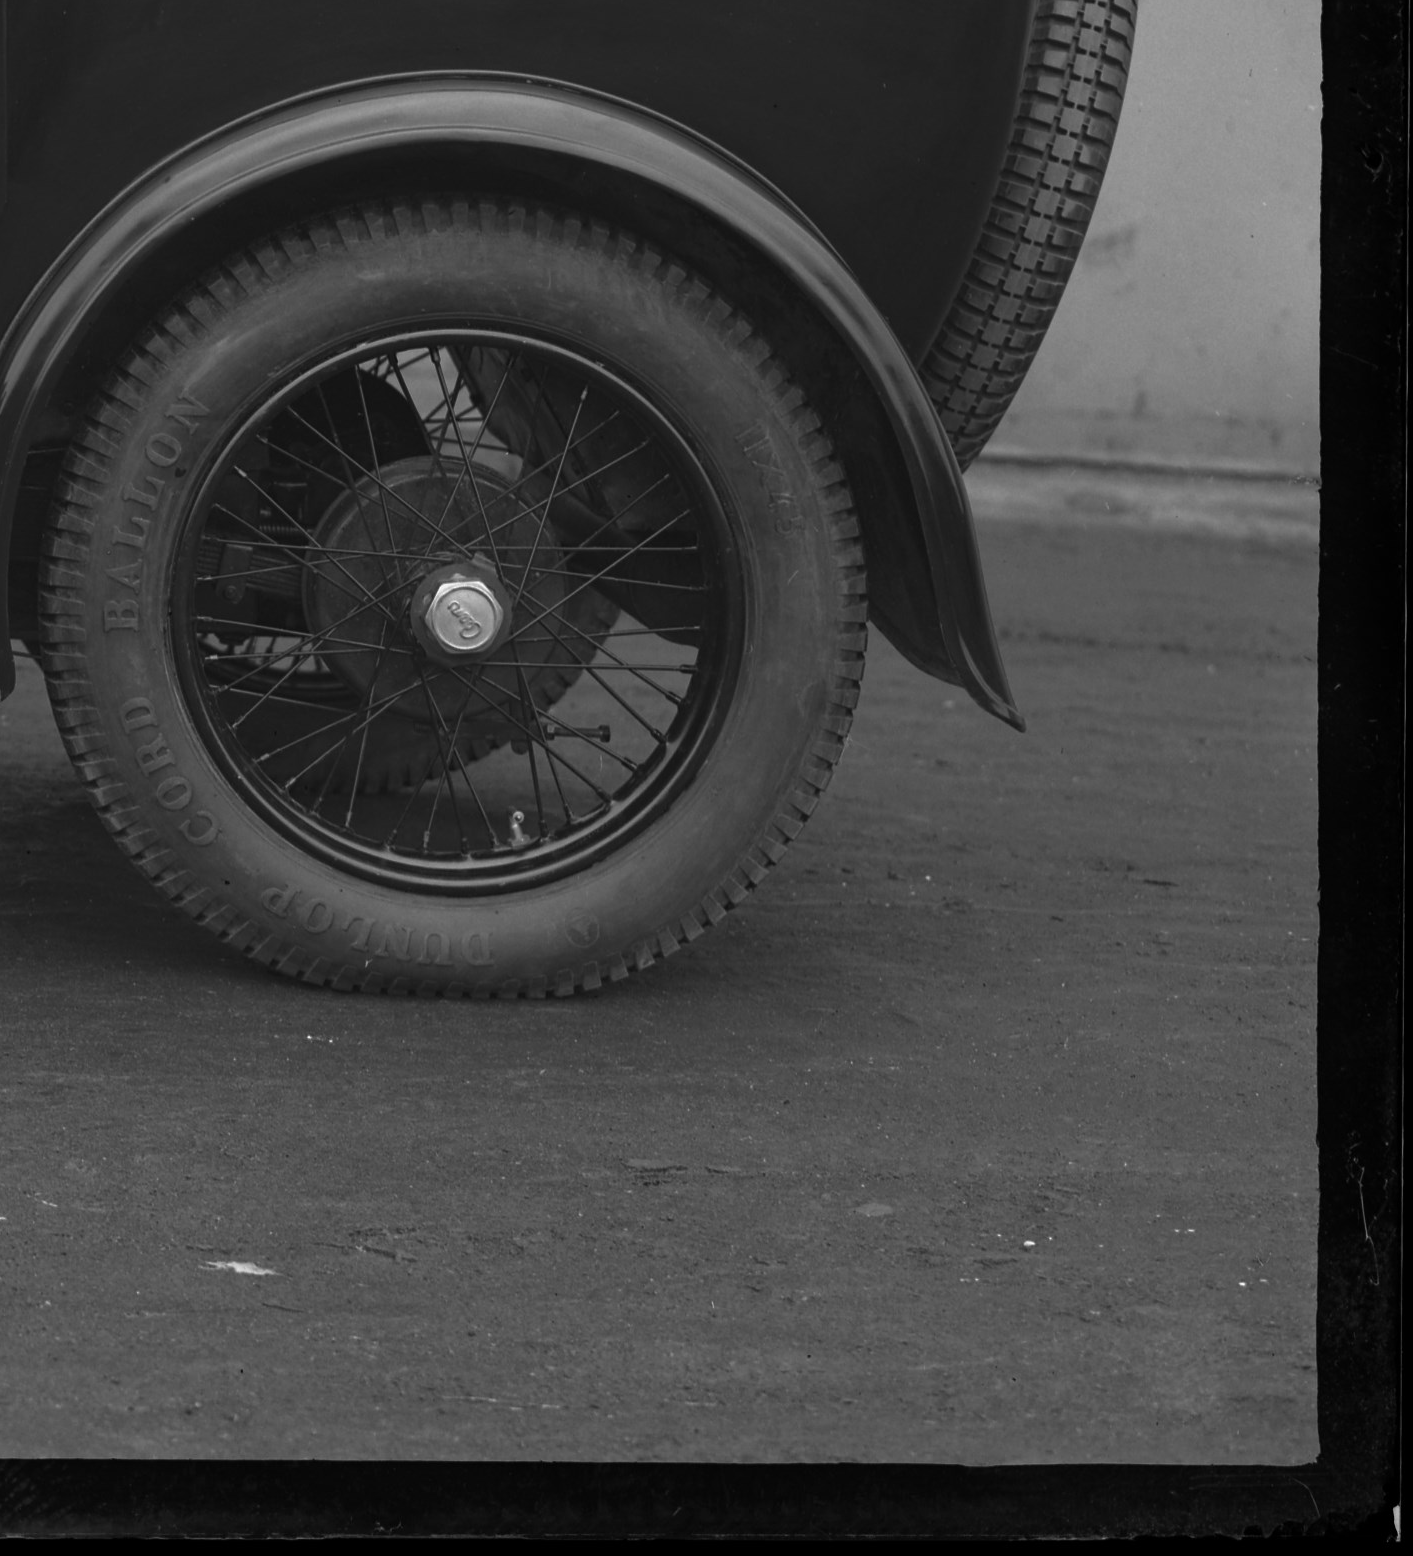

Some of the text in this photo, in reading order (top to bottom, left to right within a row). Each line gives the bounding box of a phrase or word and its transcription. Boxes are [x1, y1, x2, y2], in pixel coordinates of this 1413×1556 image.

[103, 389, 495, 967] DUNLOP CORD BALLON
